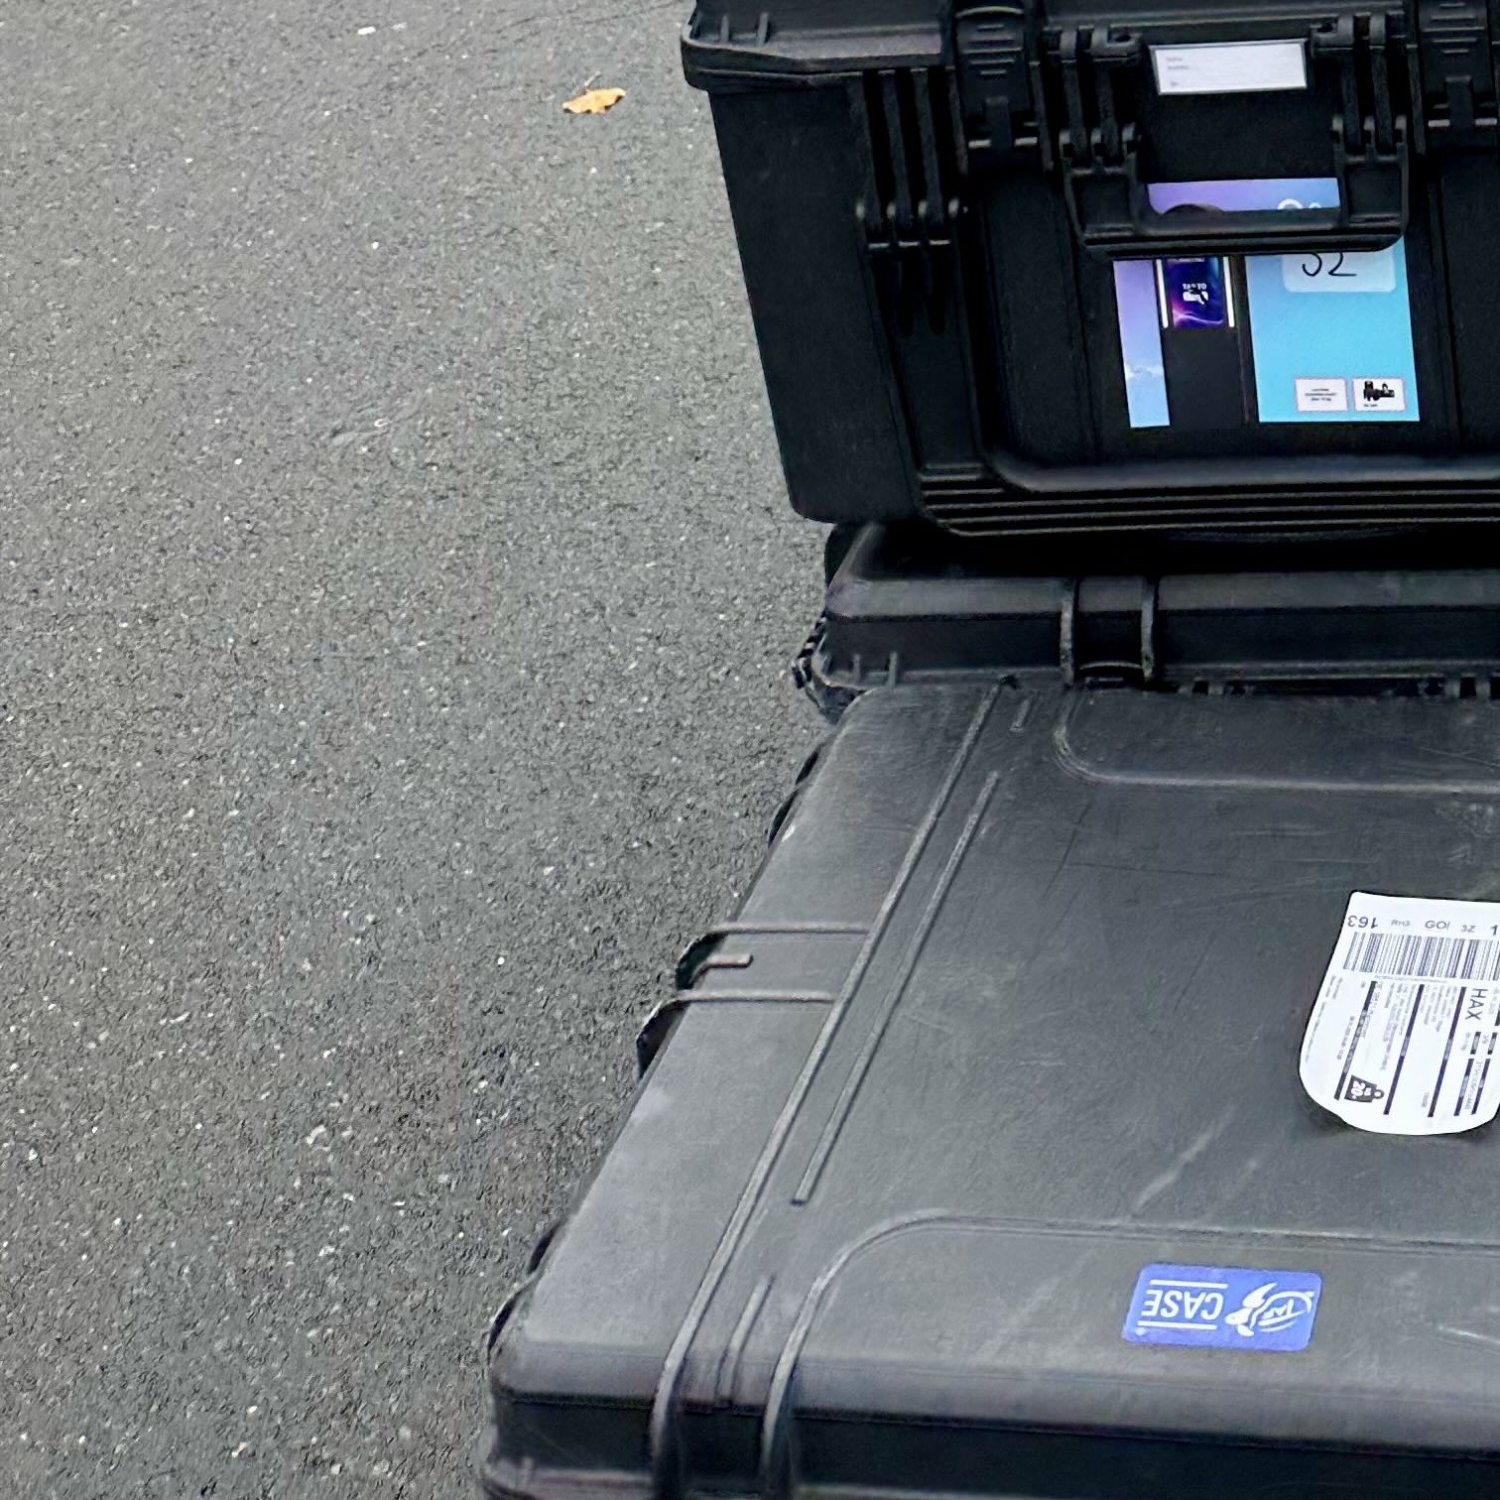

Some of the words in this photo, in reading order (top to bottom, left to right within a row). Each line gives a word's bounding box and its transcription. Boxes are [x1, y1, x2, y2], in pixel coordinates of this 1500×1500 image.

[1346, 915, 1379, 930] 163
[1464, 987, 1489, 1021] HAX
[1140, 1289, 1225, 1321] CASE
